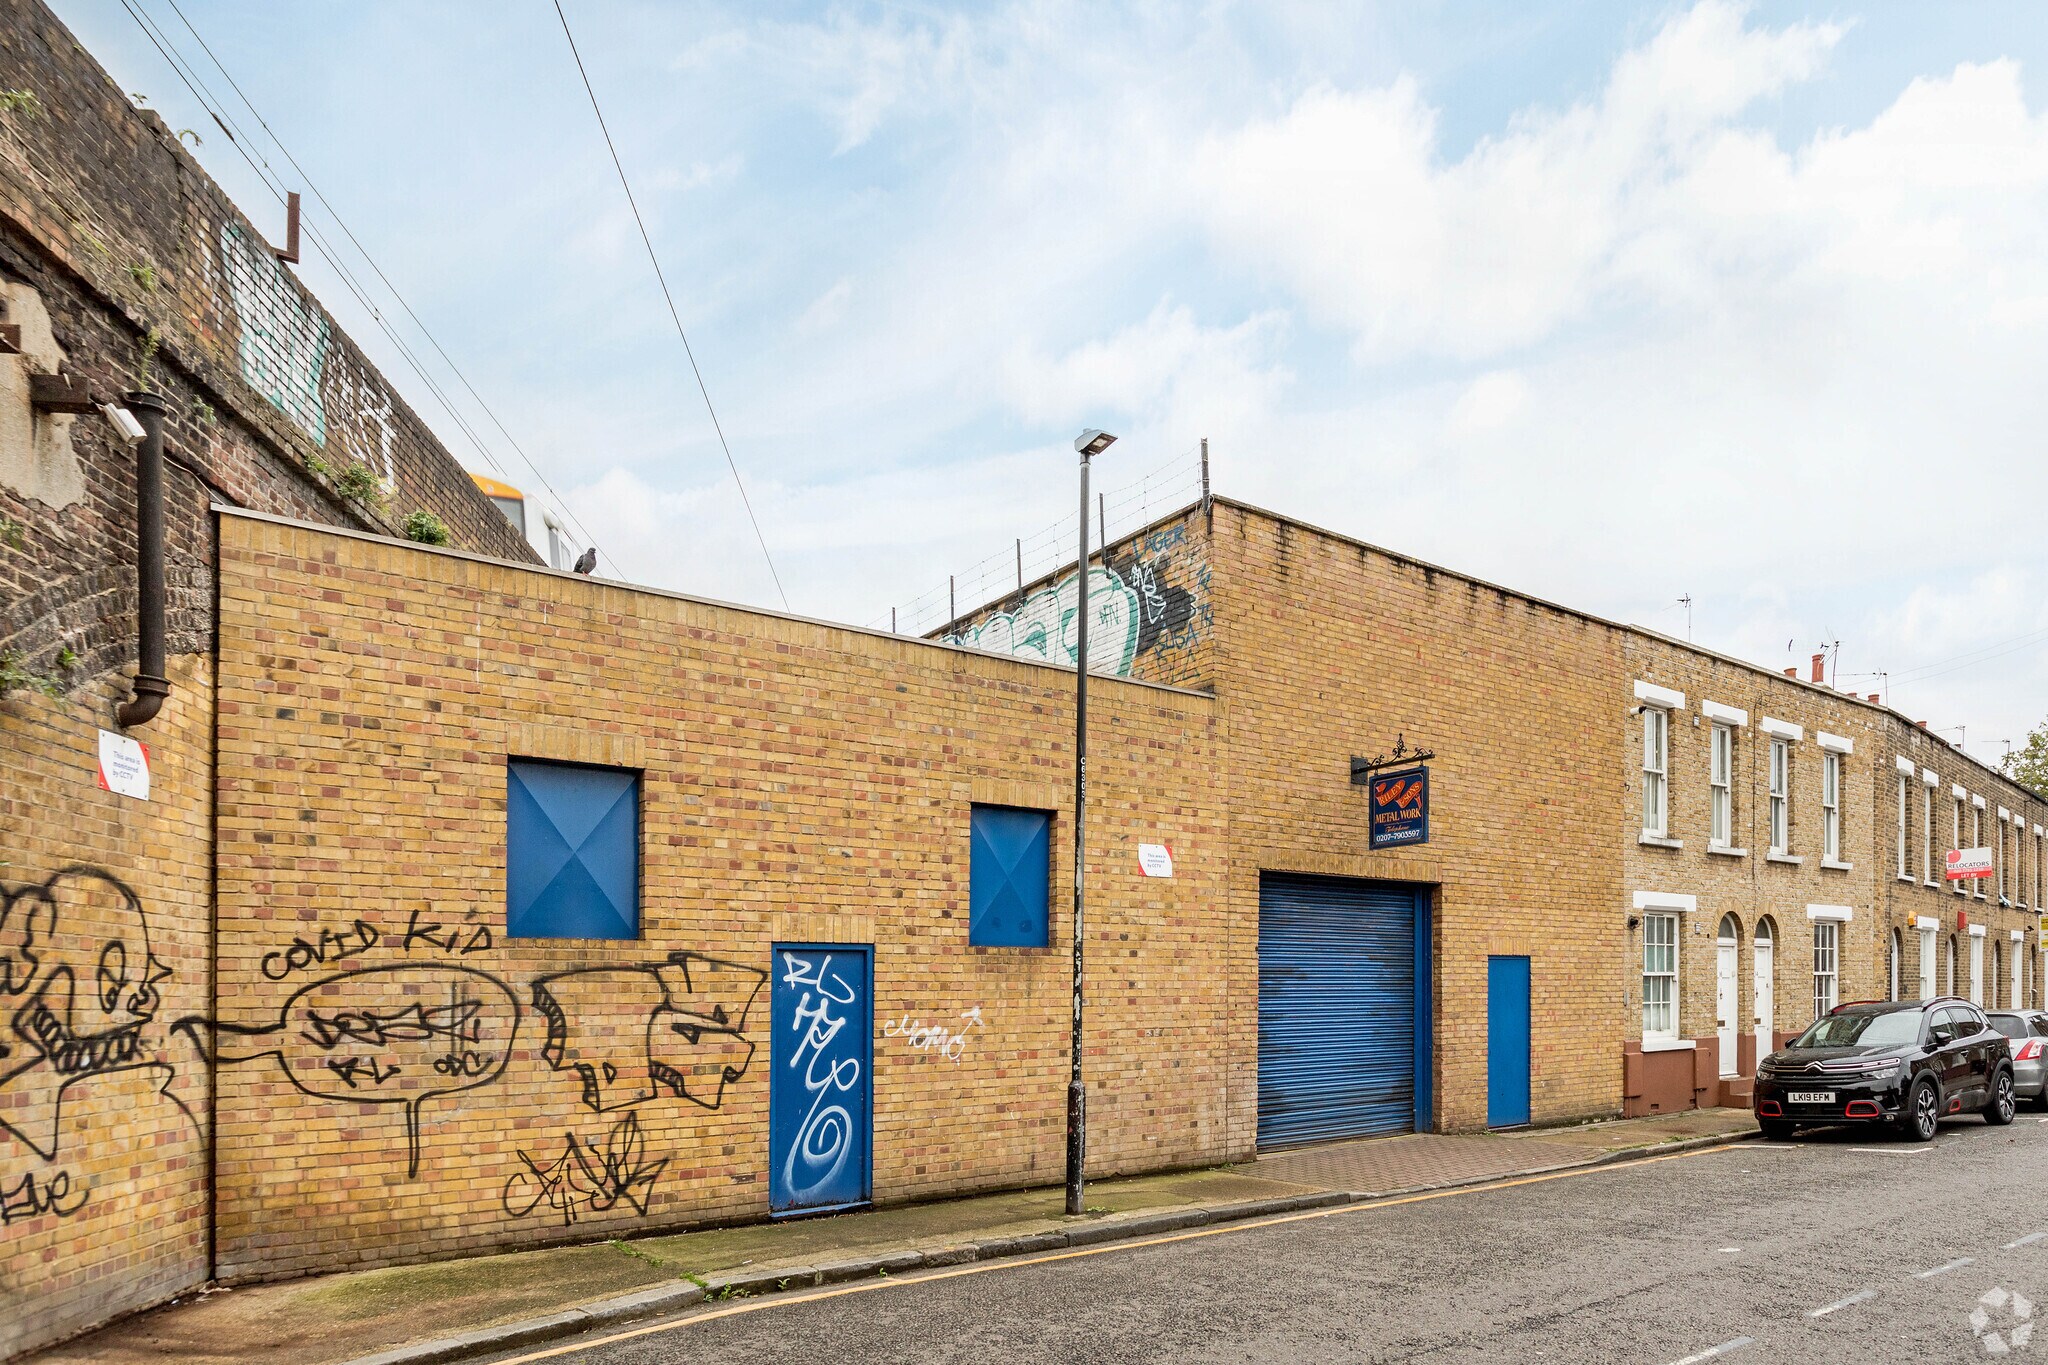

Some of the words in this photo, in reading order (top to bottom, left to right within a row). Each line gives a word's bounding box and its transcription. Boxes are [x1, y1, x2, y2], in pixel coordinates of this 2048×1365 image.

[1380, 784, 1402, 804] RILEY
[1376, 811, 1399, 823] METAL
[1400, 808, 1421, 819] WORK
[1948, 861, 1990, 869] RELOCATORS
[261, 918, 379, 980] COVID
[403, 909, 492, 955] KID
[1793, 1094, 1811, 1102] LK19
[1813, 1094, 1830, 1102] EFM
